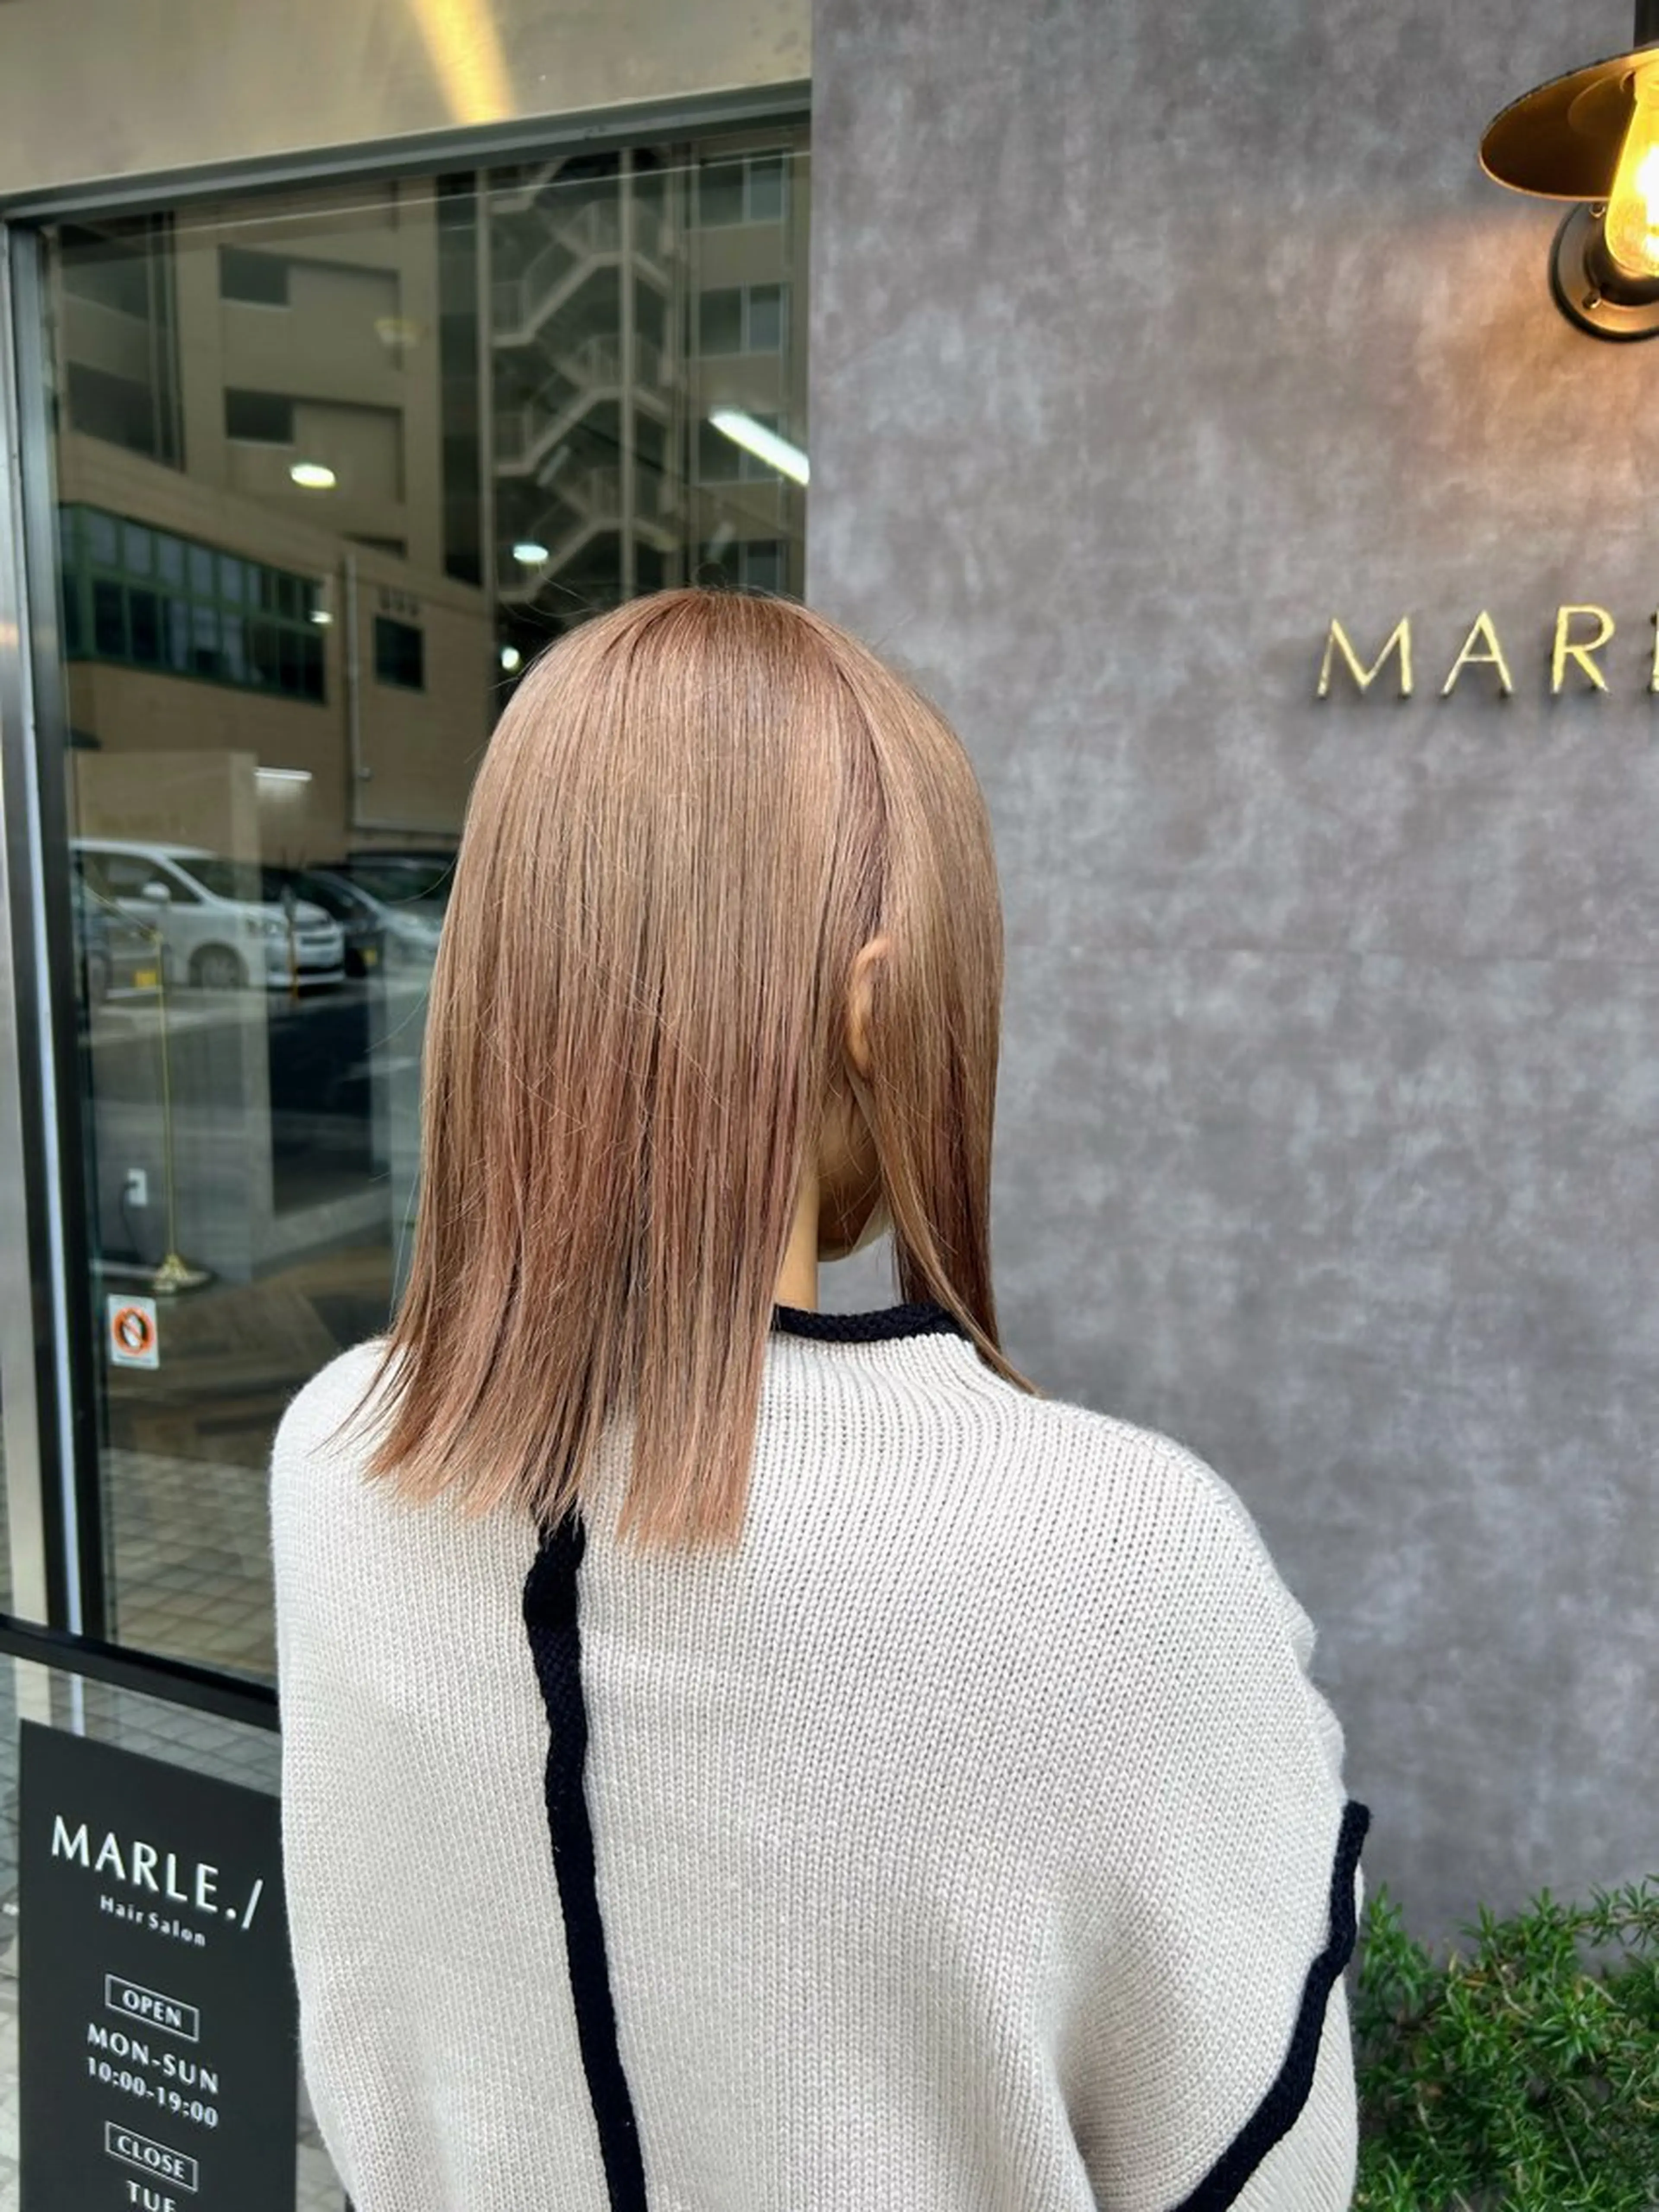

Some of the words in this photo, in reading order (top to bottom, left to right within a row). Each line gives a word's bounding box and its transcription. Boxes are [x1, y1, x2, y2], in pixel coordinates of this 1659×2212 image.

[100, 1894, 145, 1924] Hair
[147, 1911, 206, 1947] Salon
[122, 1989, 182, 2028] OPEN
[87, 2022, 219, 2094] MON-SUN
[87, 2057, 219, 2129] 10:00-19:00
[117, 2135, 184, 2179] CLOSE
